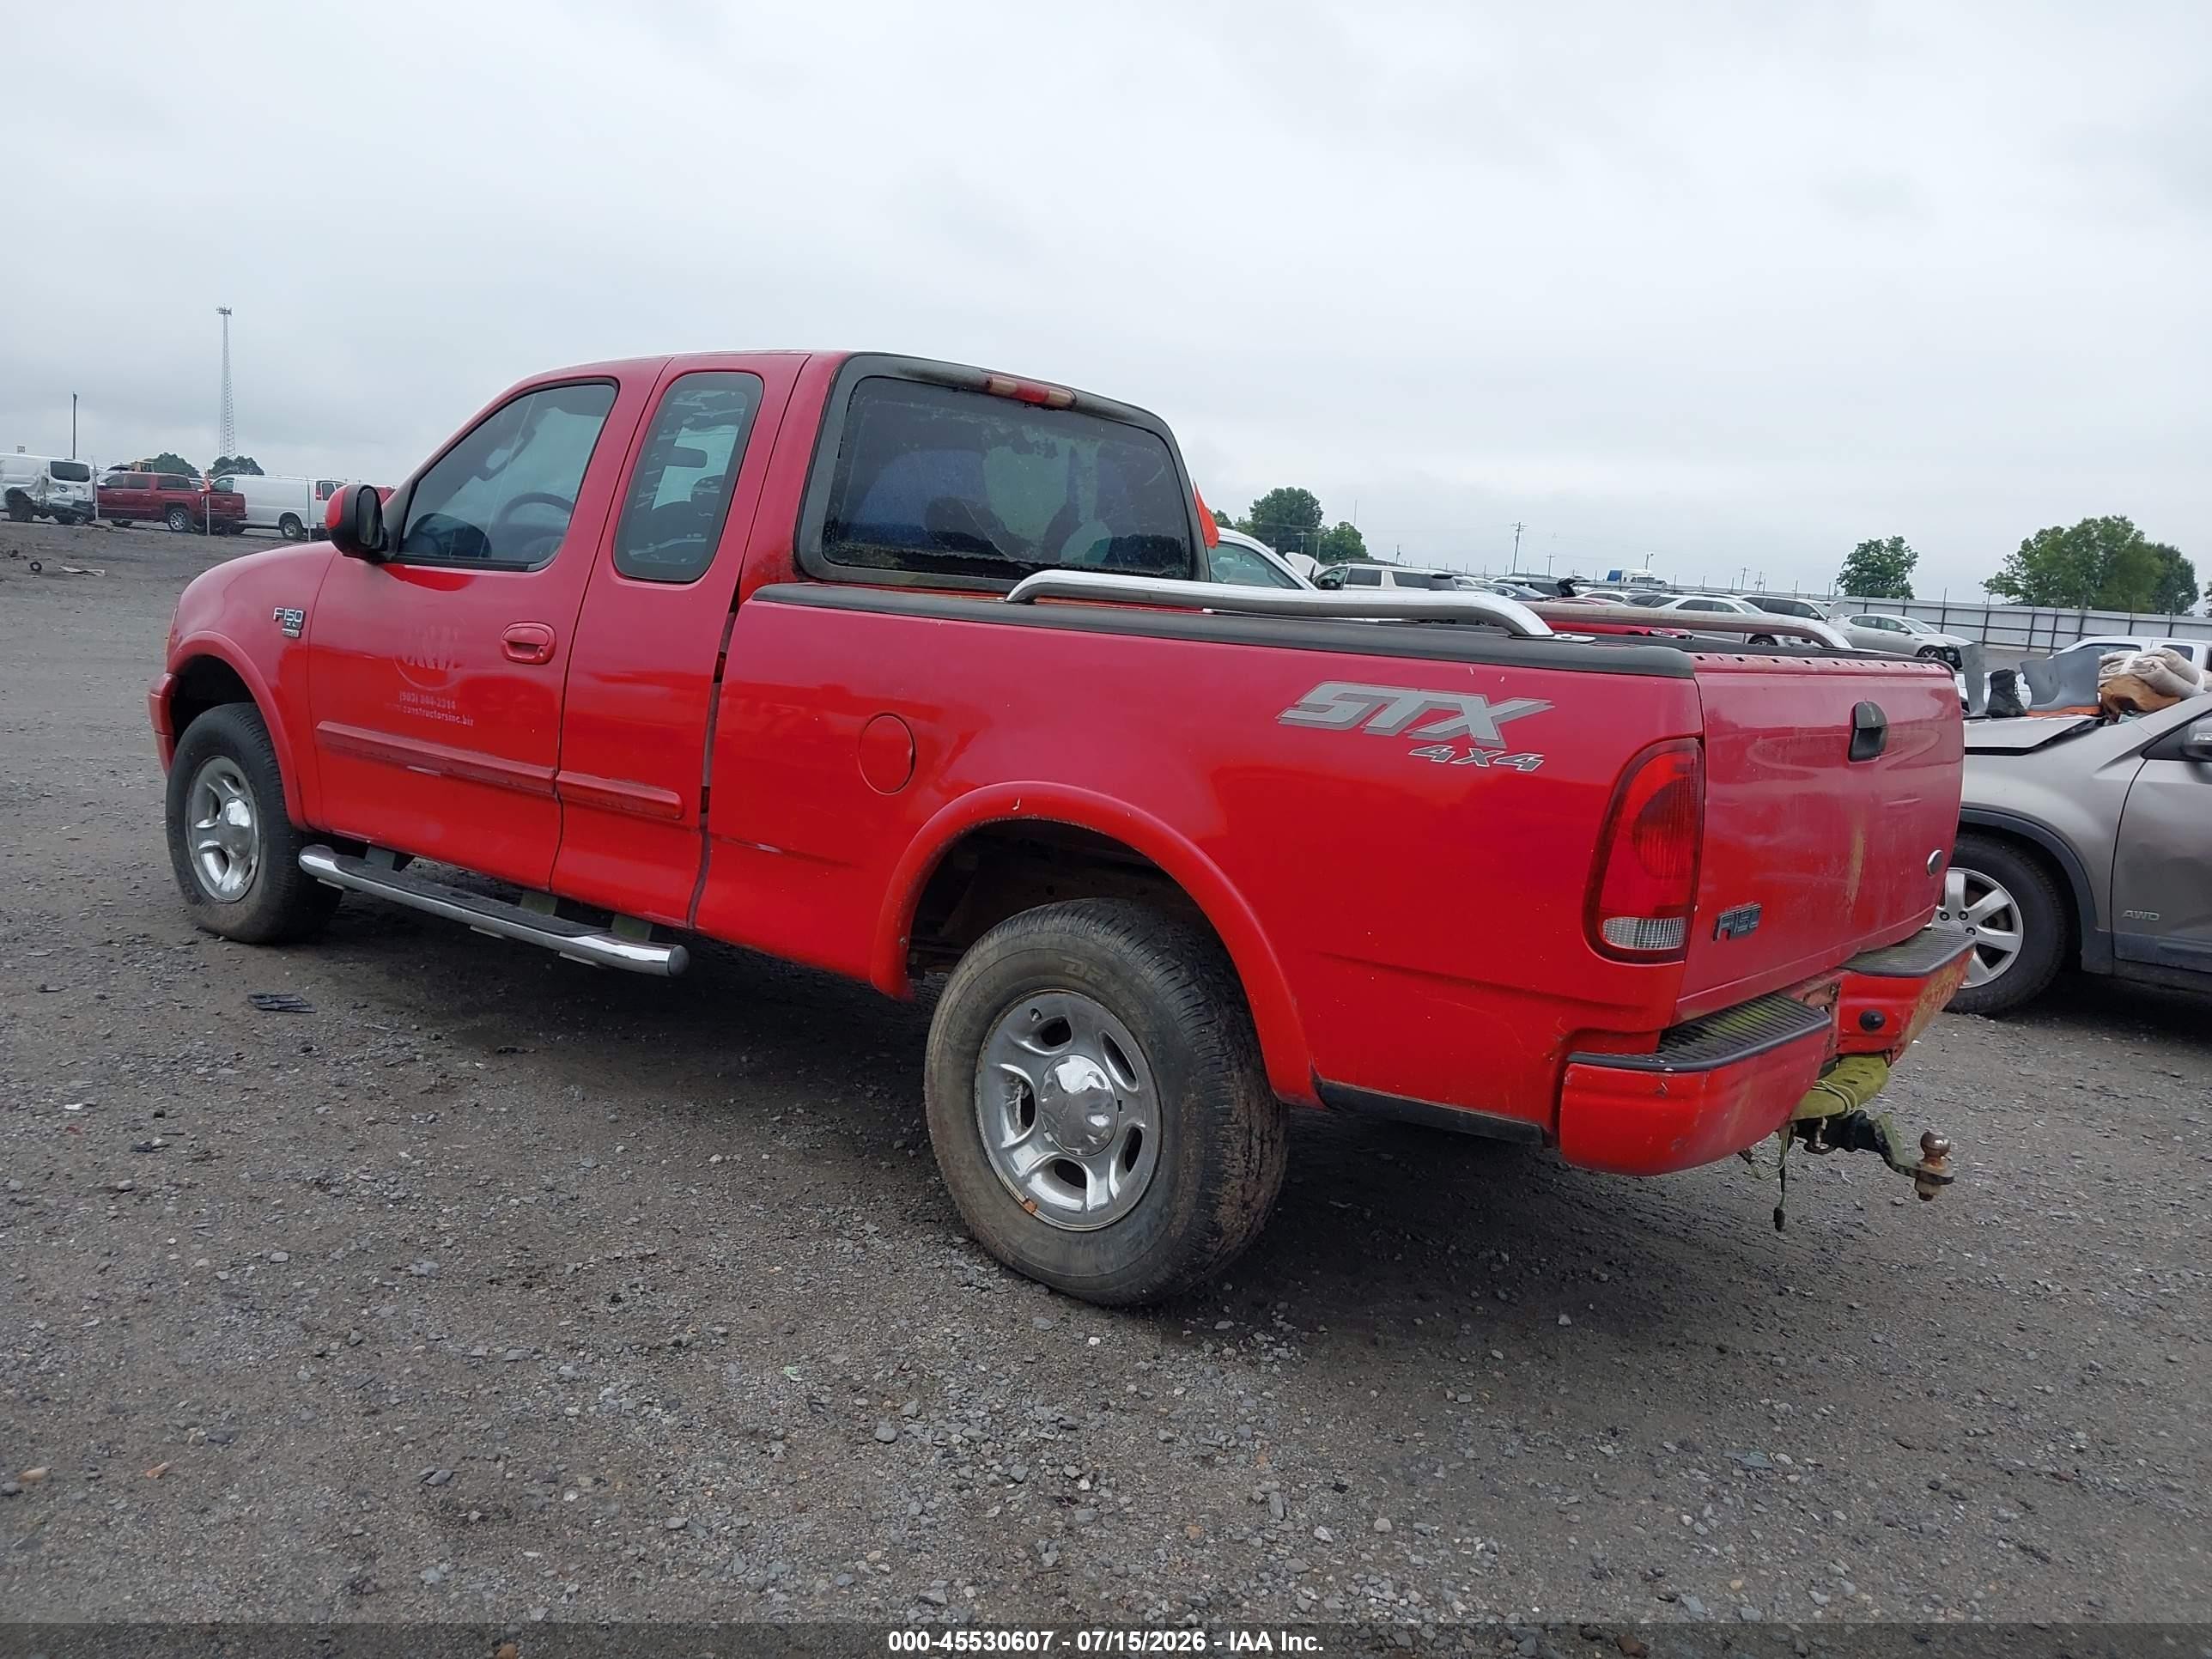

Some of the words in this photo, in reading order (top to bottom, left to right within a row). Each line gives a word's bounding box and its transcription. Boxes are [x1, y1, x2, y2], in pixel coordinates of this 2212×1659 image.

[273, 606, 304, 623] F150
[1275, 680, 1556, 750] STX
[2122, 909, 2160, 921] AWD
